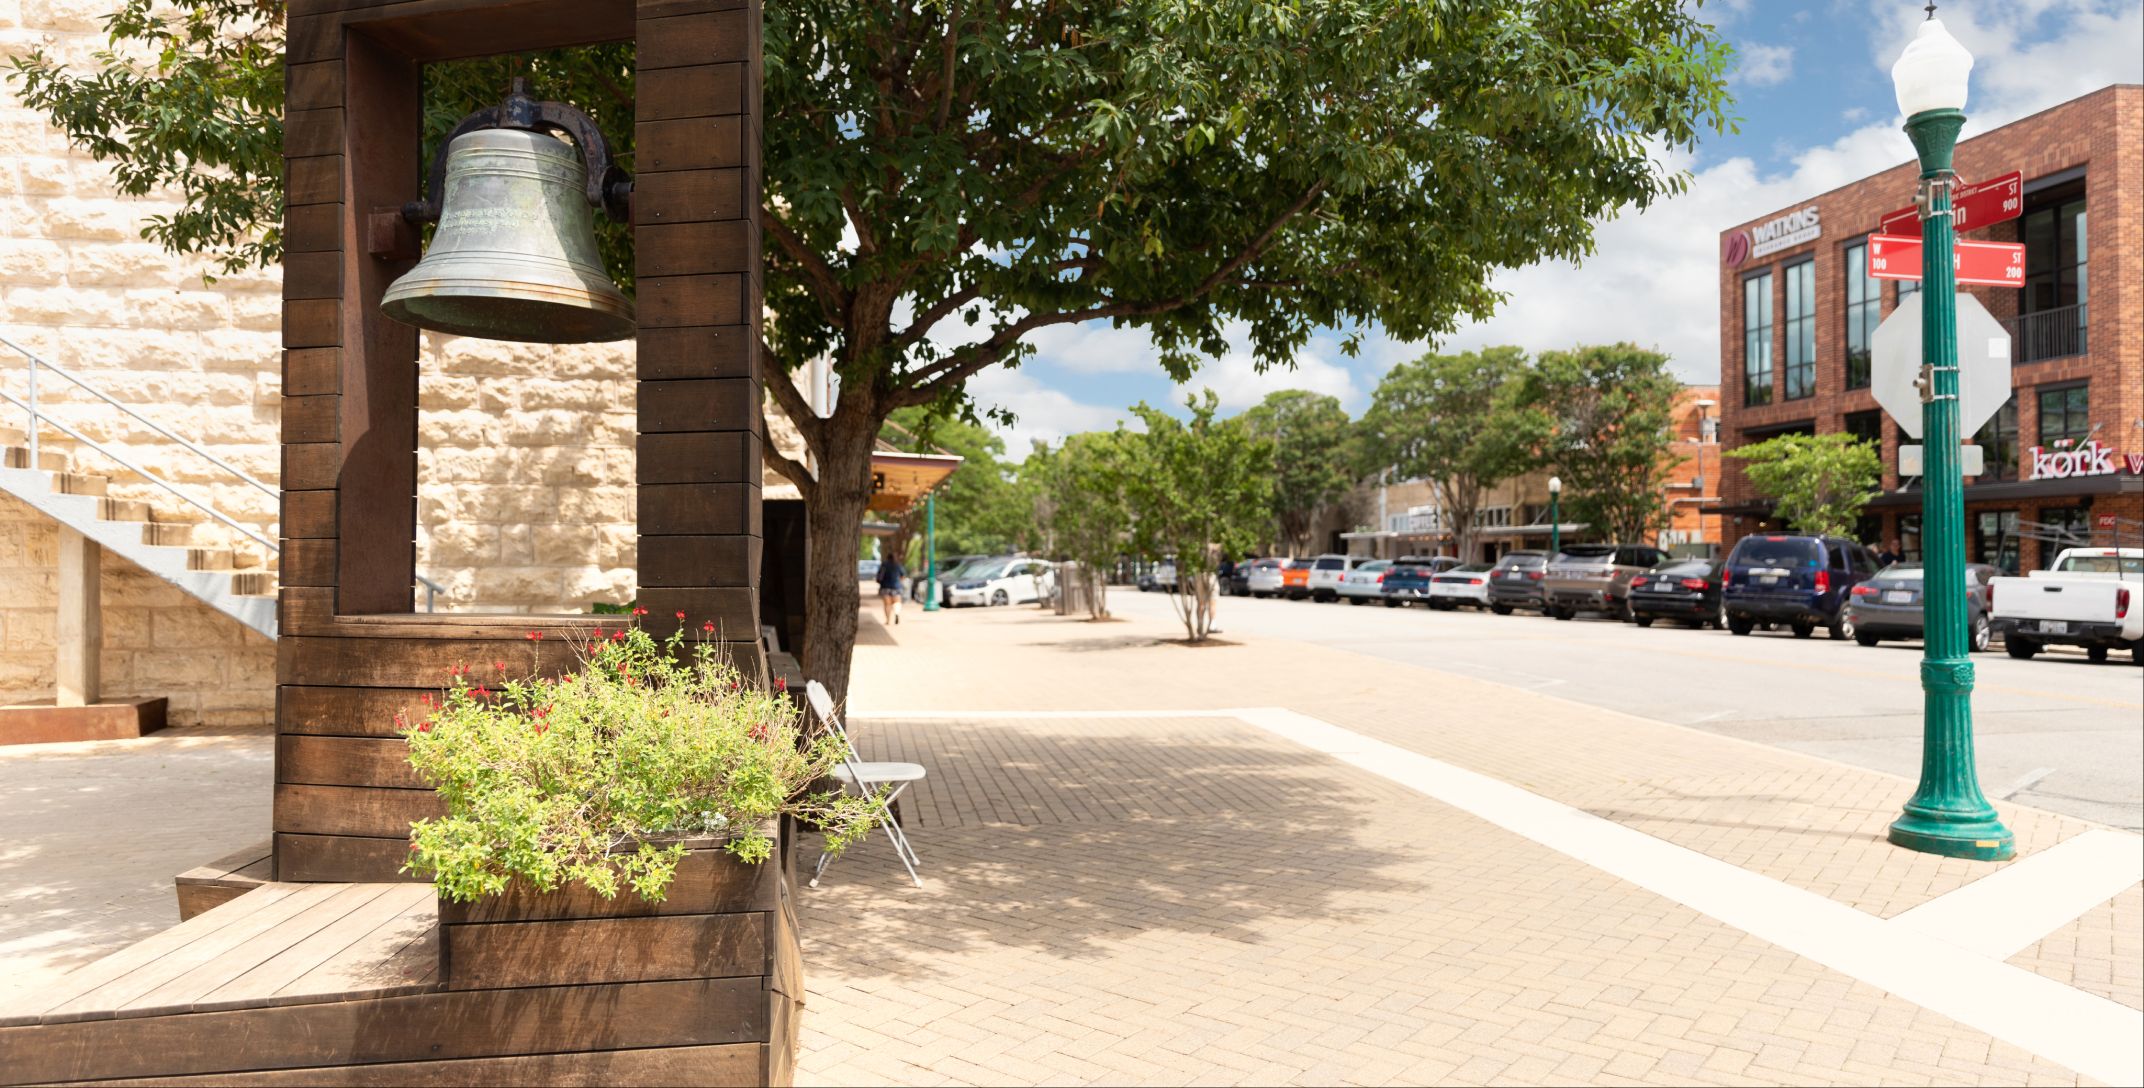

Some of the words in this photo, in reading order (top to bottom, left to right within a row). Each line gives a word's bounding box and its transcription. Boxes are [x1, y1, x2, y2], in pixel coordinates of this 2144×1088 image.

[1882, 225, 1888, 236] S
[1952, 204, 1966, 226] in
[2008, 182, 2018, 196] ST
[2003, 197, 2018, 212] 900
[1753, 206, 1819, 244] WATKINS
[1873, 243, 1881, 254] W
[1953, 253, 1961, 270] H
[2013, 253, 2022, 264] ST
[1873, 258, 1886, 270] 100
[2006, 266, 2022, 279] 200
